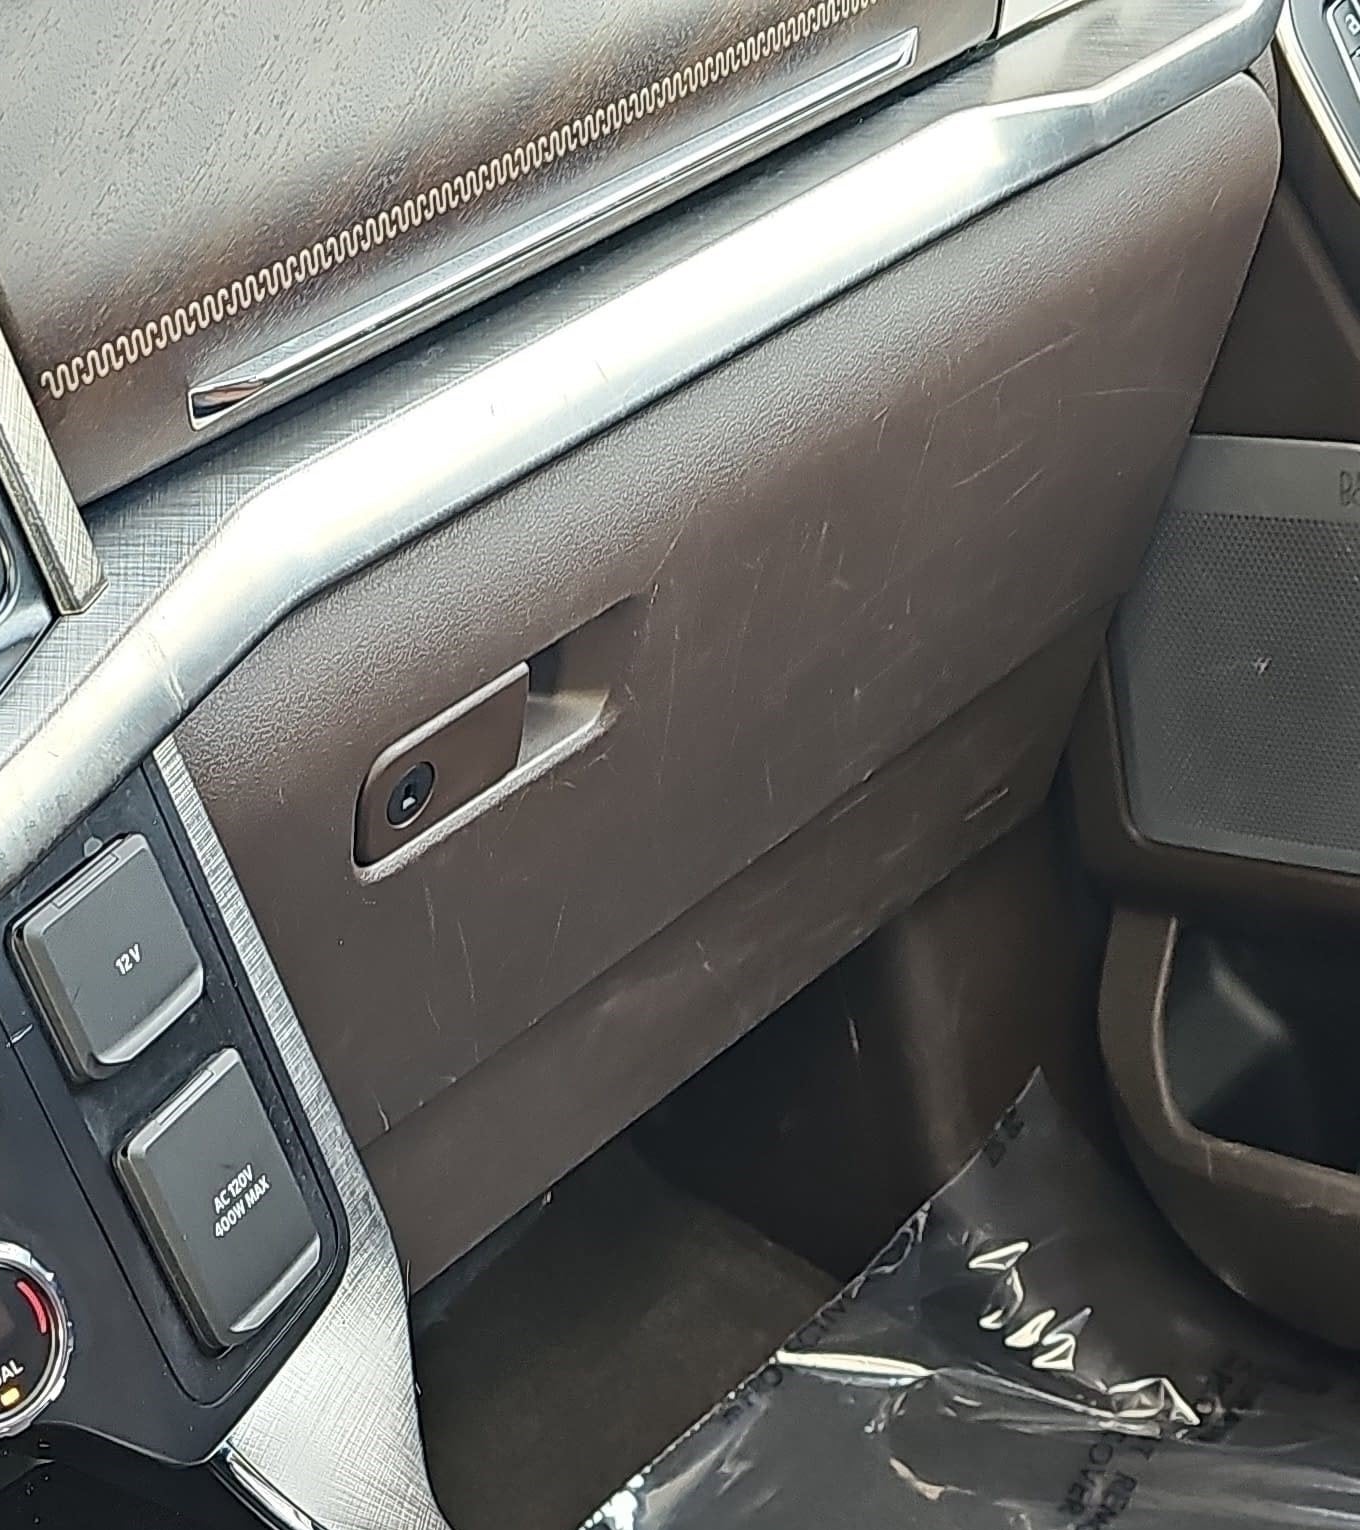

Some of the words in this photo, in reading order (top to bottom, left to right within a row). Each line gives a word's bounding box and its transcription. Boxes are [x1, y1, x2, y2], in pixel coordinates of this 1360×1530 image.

[214, 1188, 231, 1214] AC
[227, 1163, 253, 1198] 120V
[214, 1198, 246, 1237] 400W
[244, 1174, 270, 1209] MAX
